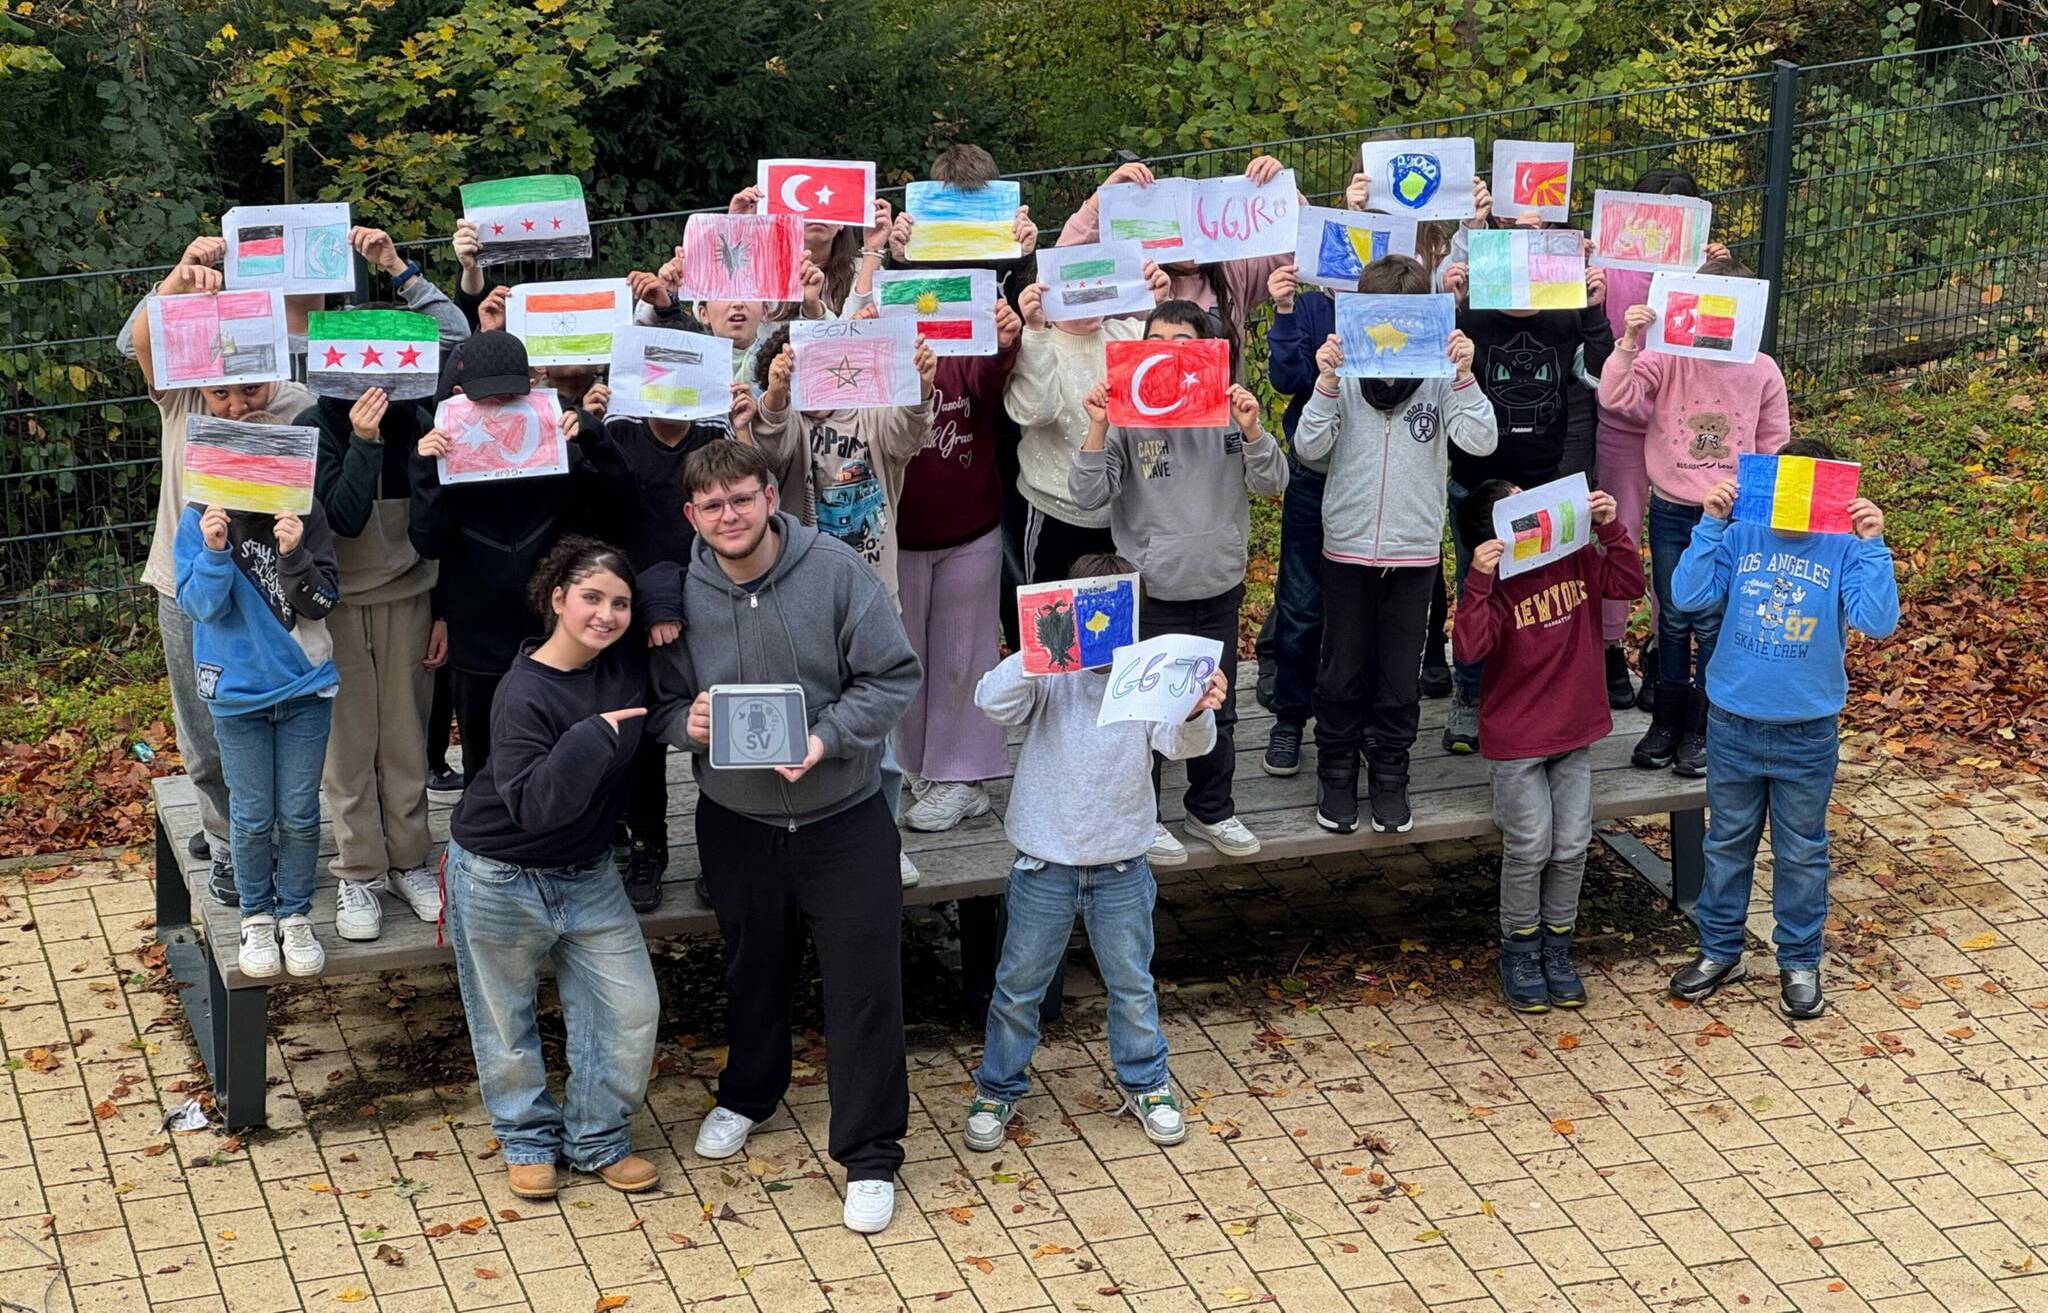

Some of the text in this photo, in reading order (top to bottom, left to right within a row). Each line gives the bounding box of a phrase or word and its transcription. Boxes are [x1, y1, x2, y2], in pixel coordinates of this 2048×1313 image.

[1138, 440, 1169, 458] CATCH
[1142, 462, 1171, 480] WAVE
[1766, 553, 1831, 590] ANGELES
[1783, 616, 1818, 642] 97
[1734, 631, 1771, 656] SKATE
[1773, 642, 1809, 659] CREW
[746, 733, 771, 750] SV
